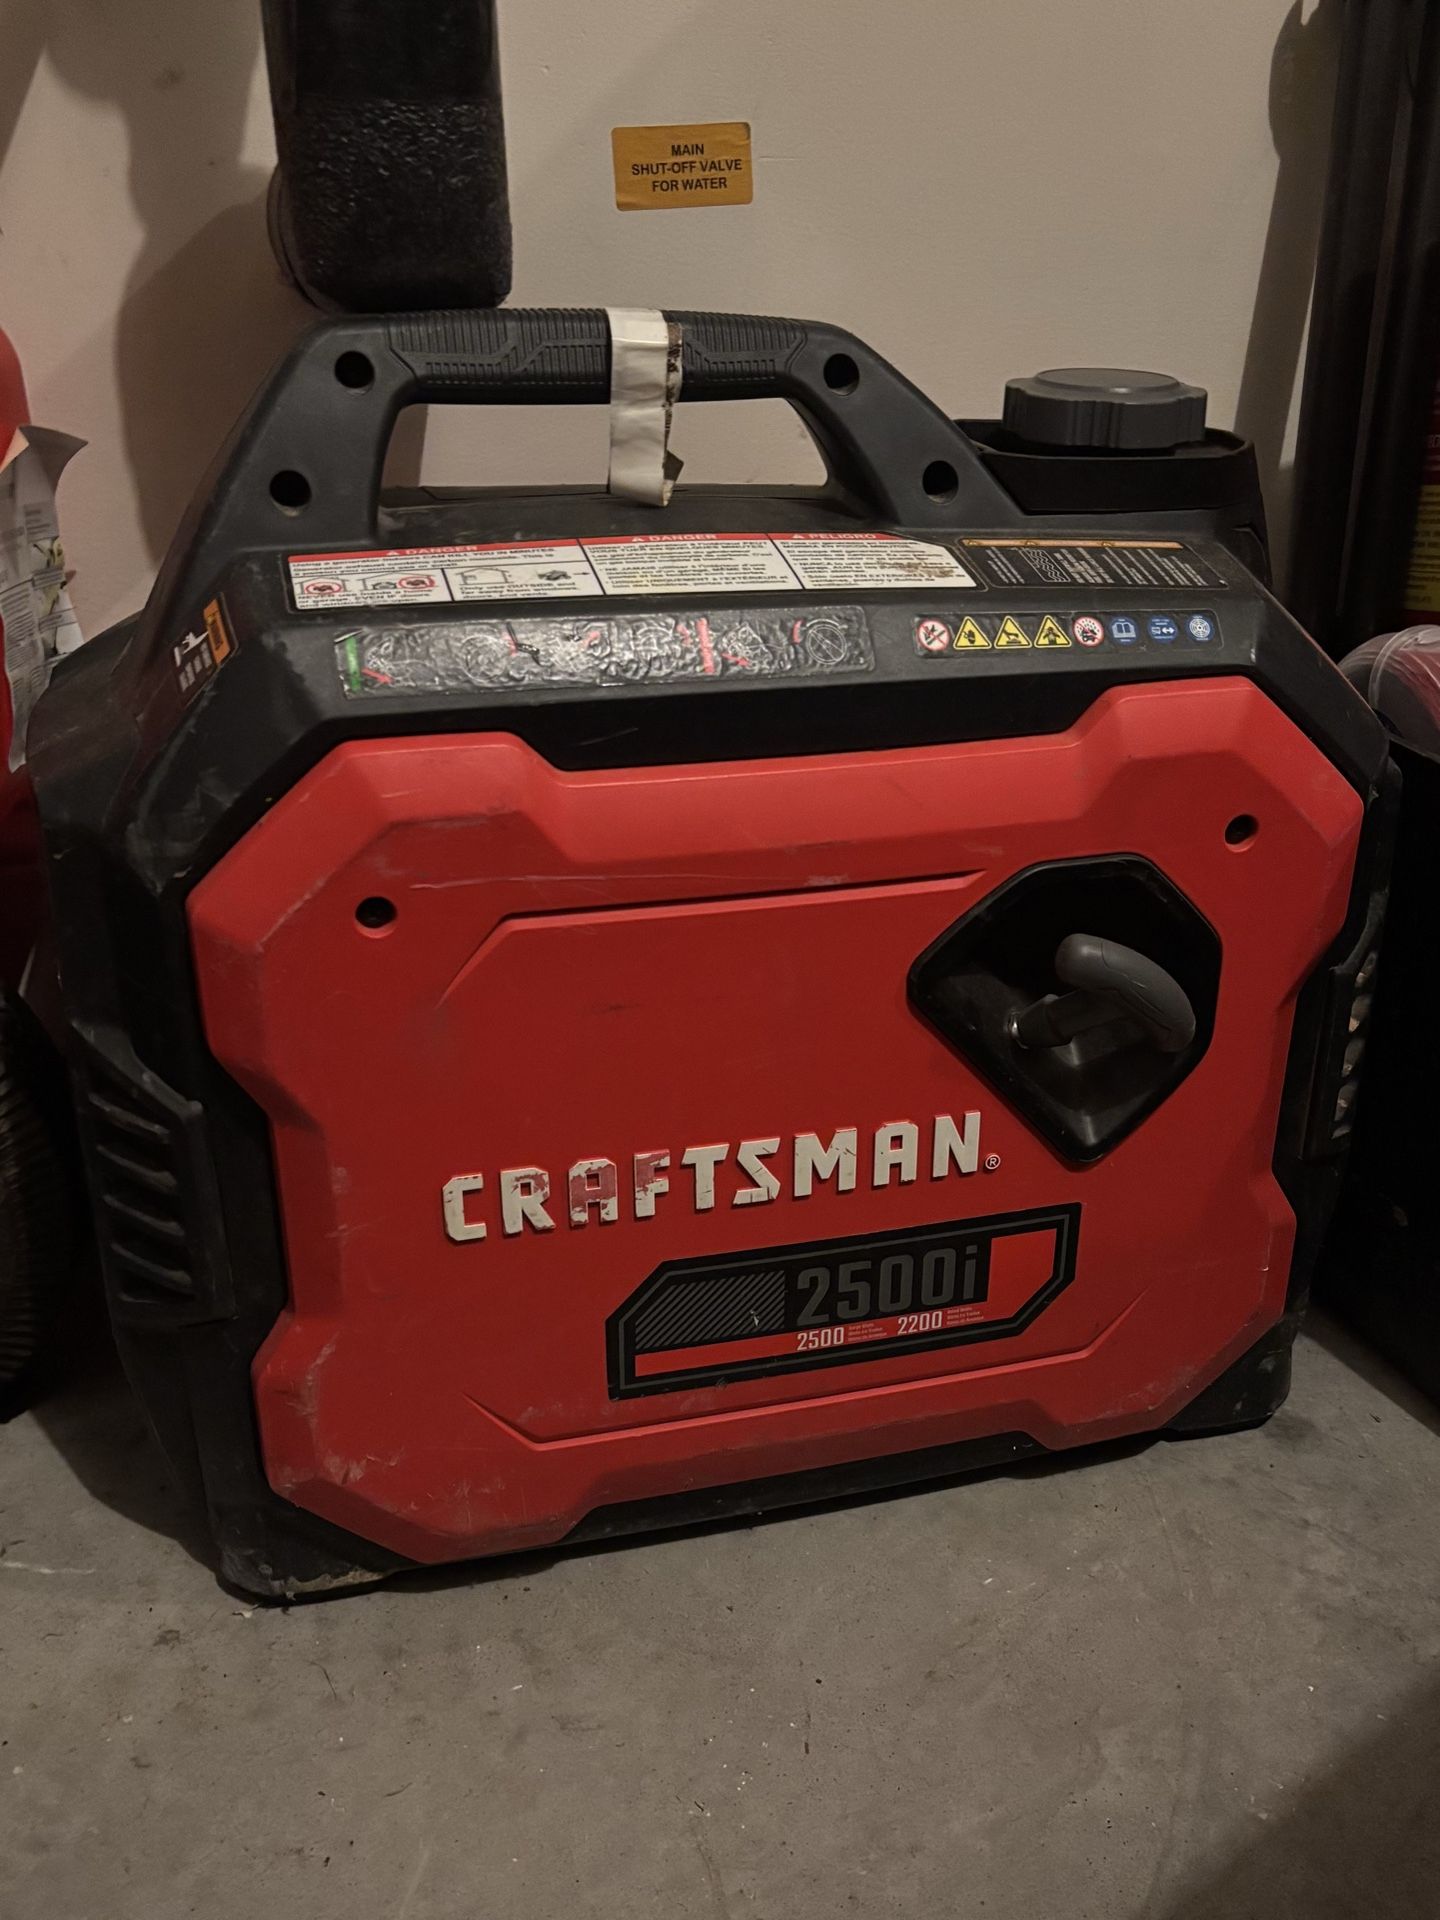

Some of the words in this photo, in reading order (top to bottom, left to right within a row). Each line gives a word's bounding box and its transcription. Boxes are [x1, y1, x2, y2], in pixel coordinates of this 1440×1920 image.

[671, 144, 704, 156] MAIN
[632, 161, 697, 176] SHUT-OFF
[700, 159, 743, 172] VALVE
[652, 179, 679, 192] FOR
[682, 177, 727, 191] WATER
[405, 546, 478, 555] DANGER
[442, 1110, 981, 1241] CRAFTSMAN
[796, 1244, 978, 1326] 2500i
[796, 1327, 844, 1351] 2500
[898, 1311, 943, 1335] 2200
